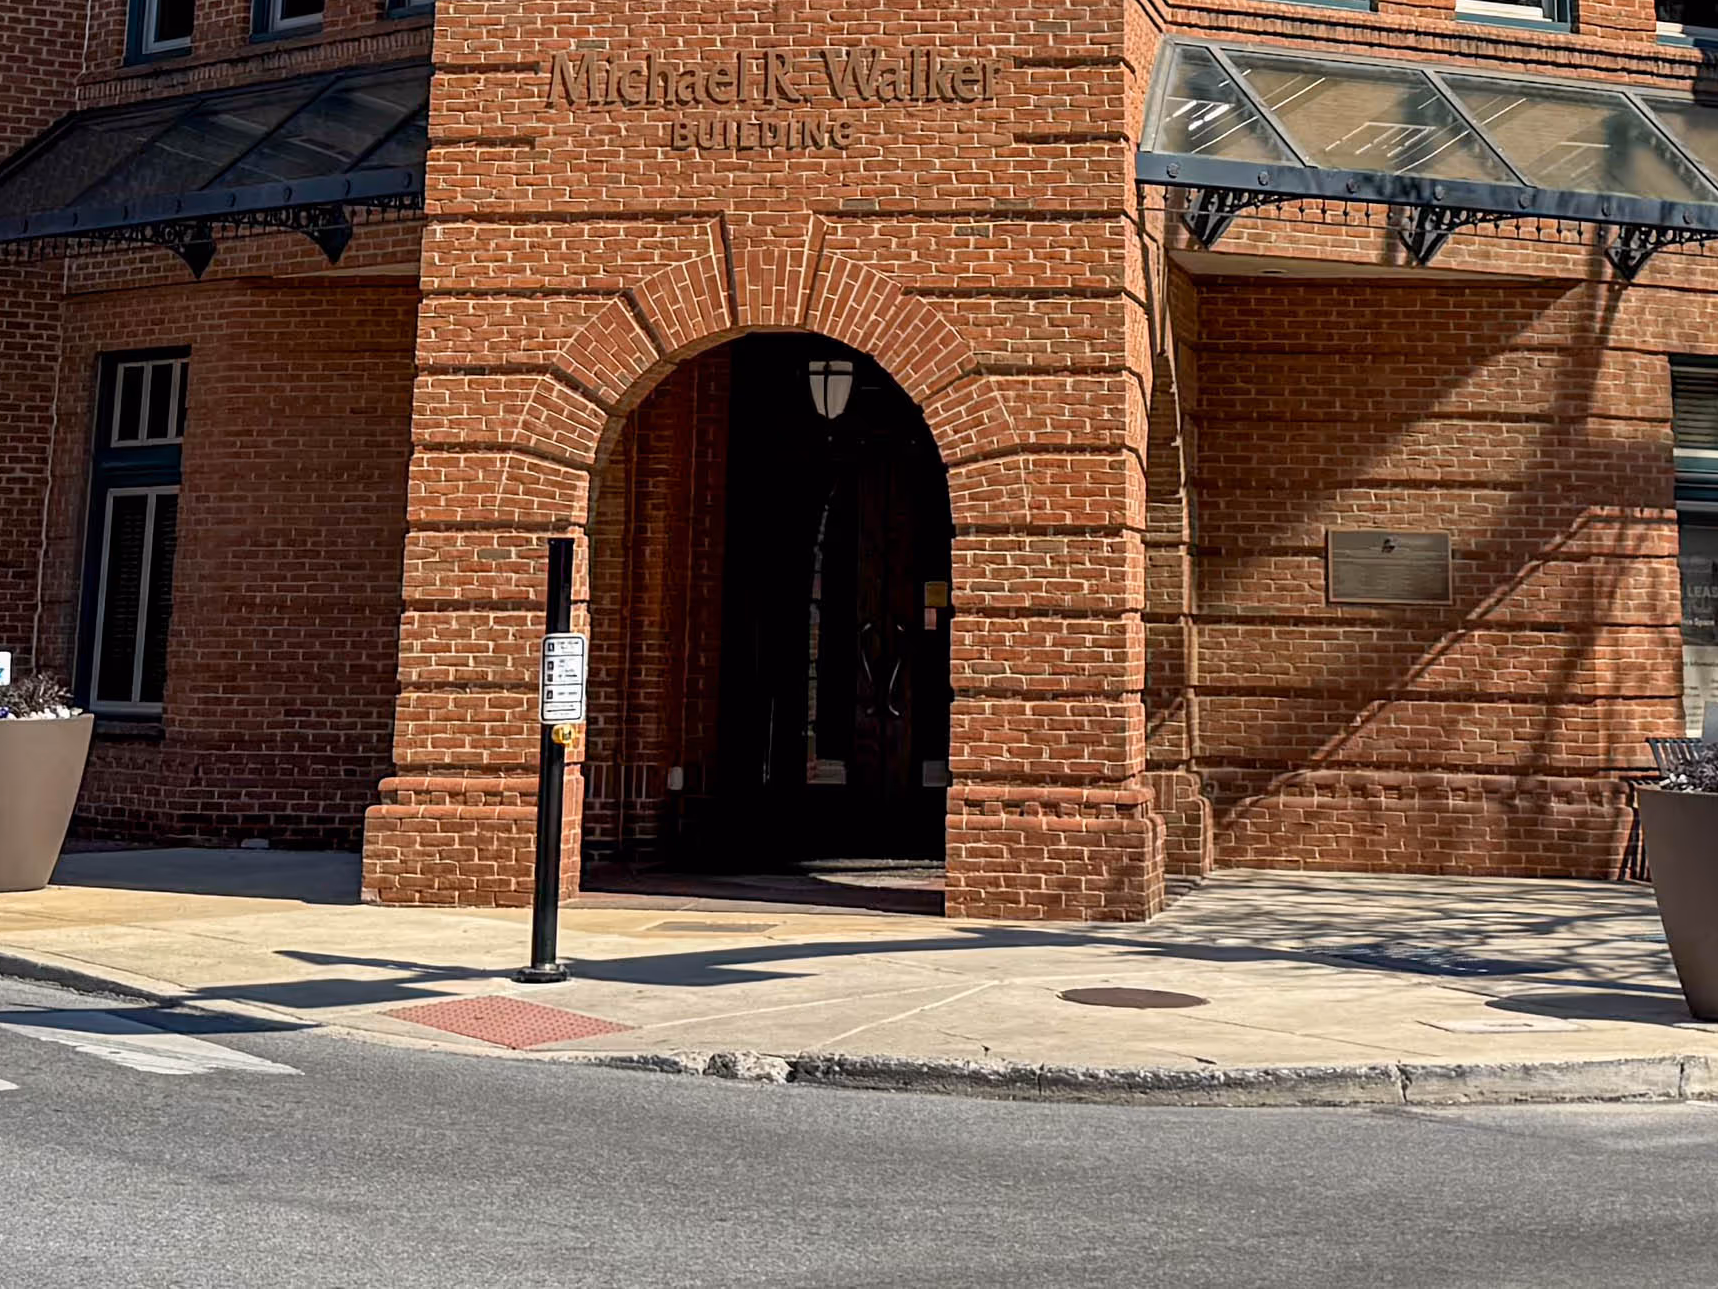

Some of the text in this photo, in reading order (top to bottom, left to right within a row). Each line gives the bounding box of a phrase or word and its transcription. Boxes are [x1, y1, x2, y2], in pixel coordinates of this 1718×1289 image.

[546, 46, 1002, 107] Michael R. Walker
[671, 116, 858, 151] BUILDING
